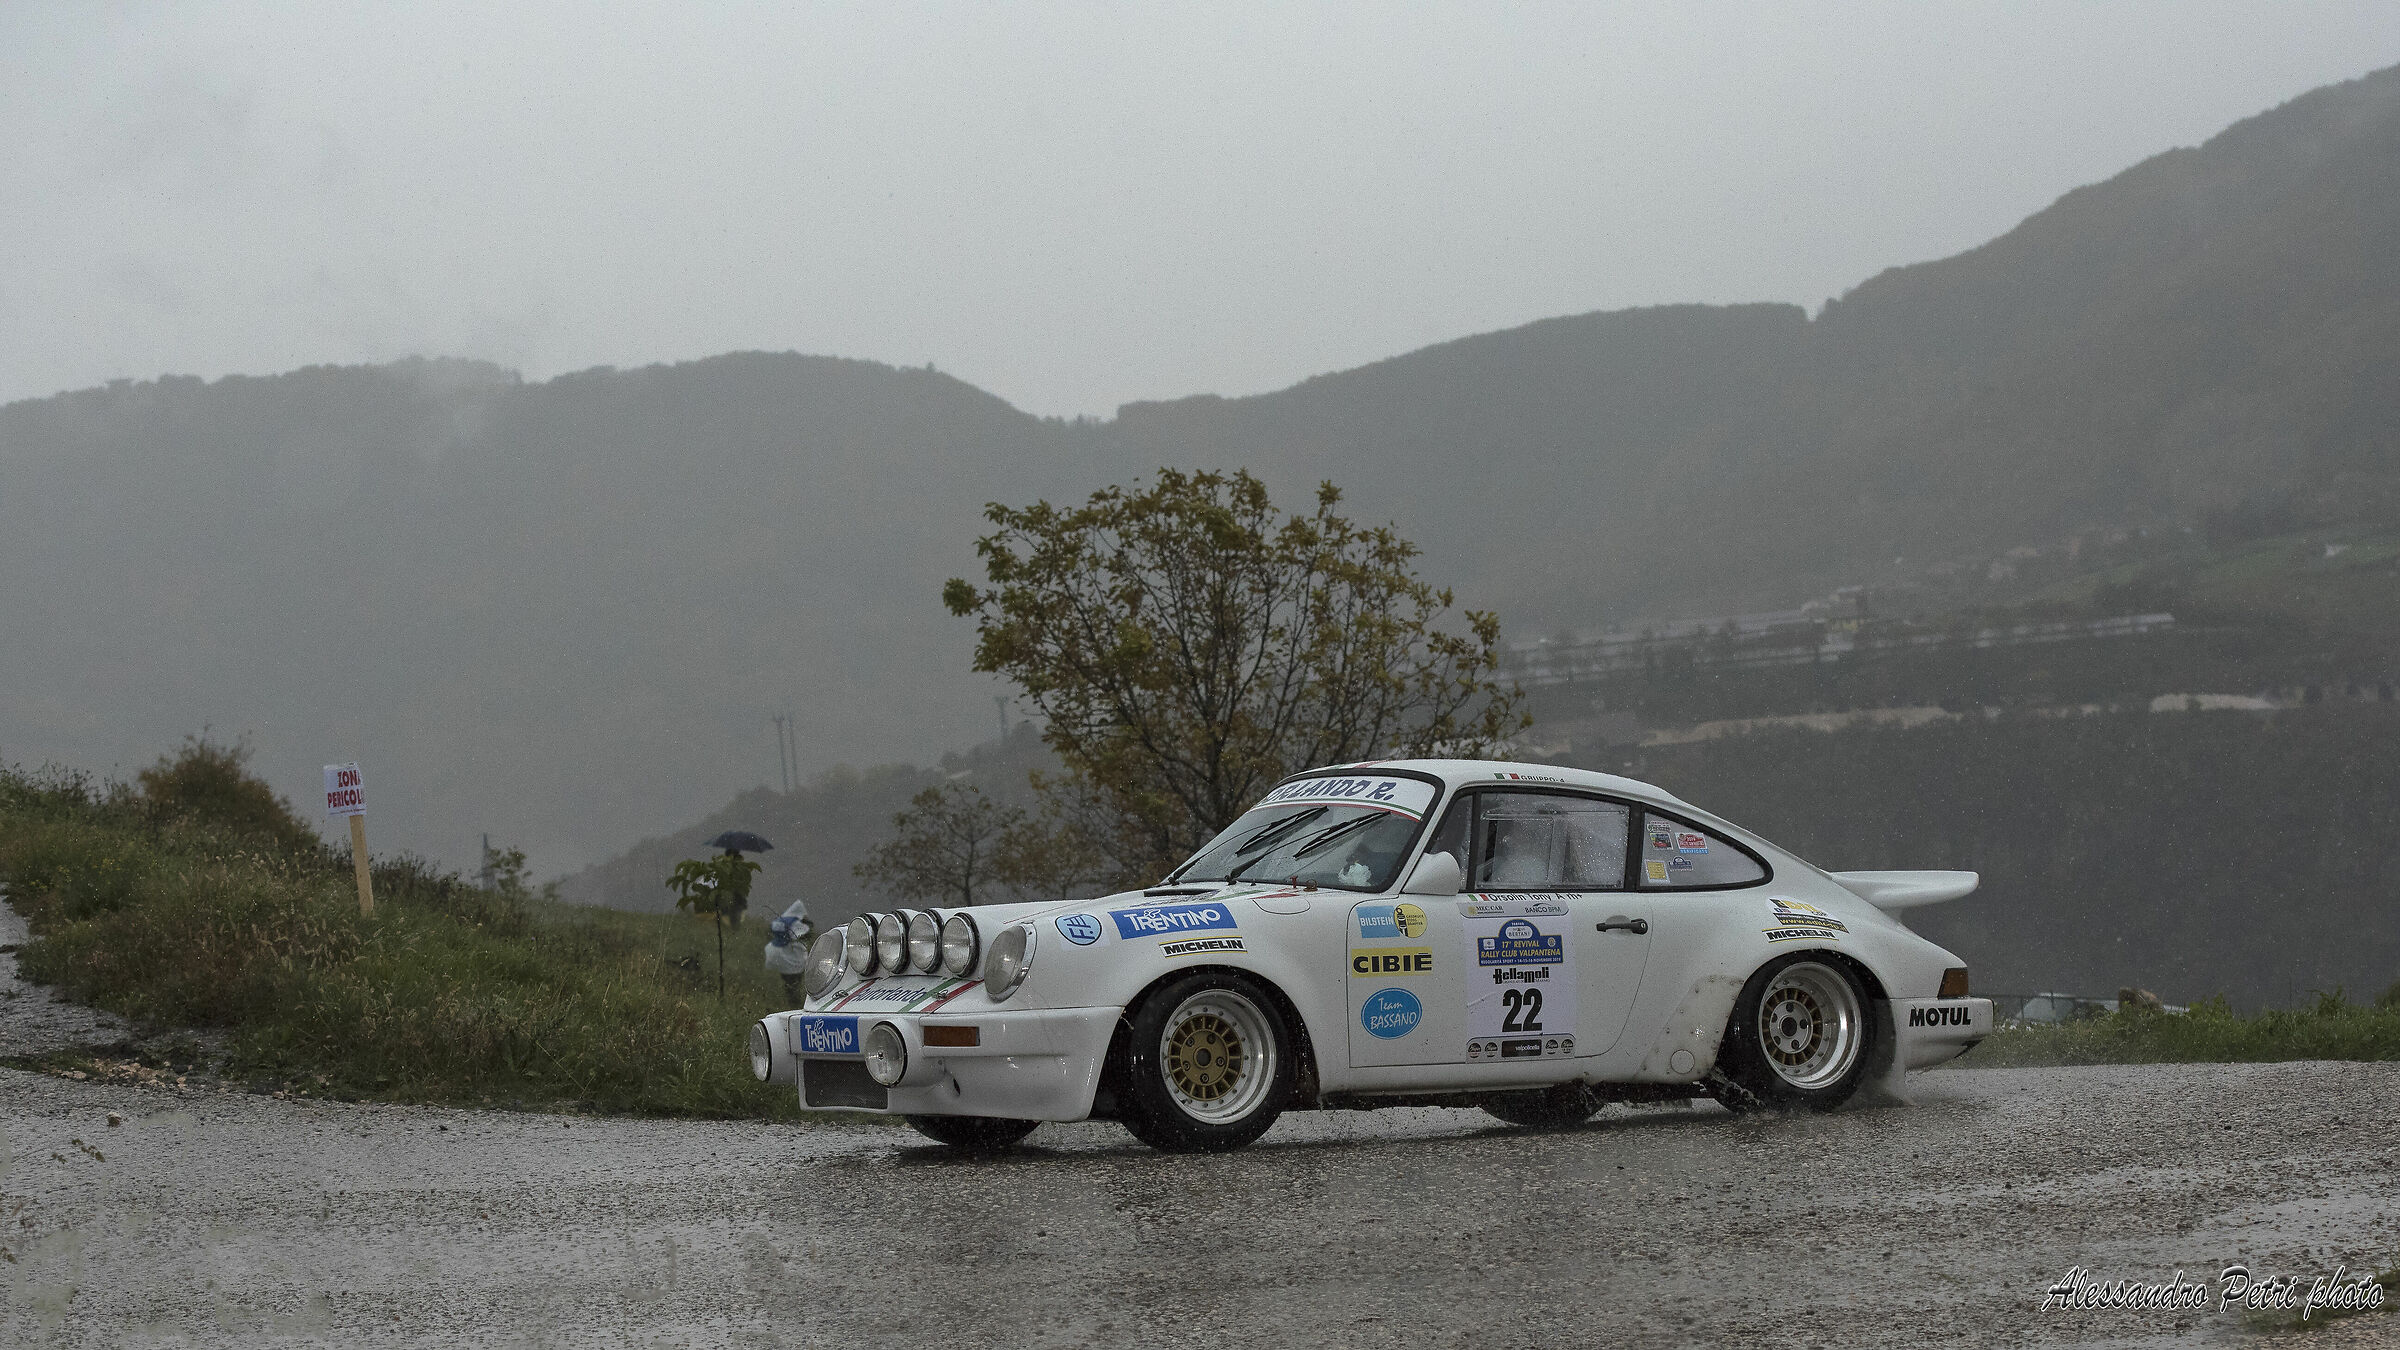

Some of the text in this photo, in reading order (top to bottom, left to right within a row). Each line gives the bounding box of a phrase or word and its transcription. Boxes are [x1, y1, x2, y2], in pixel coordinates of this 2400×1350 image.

[327, 788, 364, 809] PERICOL
[1266, 779, 1397, 802] ORLANDO R.
[1488, 893, 1526, 902] Orsolin
[1525, 906, 1548, 914] BANCO
[1124, 908, 1221, 931] TRENTINO
[1360, 916, 1394, 927] BILSTEIN
[1766, 929, 1836, 940] MICHELIN
[1164, 939, 1243, 955] MICHELIN
[1513, 940, 1540, 948] REVIVAL
[1481, 948, 1561, 958] RALLY CLUB VALPANTENA
[1492, 966, 1549, 985] Bellamoli
[1378, 997, 1403, 1011] Team
[1501, 988, 1543, 1033] 22
[1370, 1011, 1417, 1030] BASSANO
[1908, 1005, 1971, 1027] MOTUL
[805, 1024, 853, 1053] TRENTINO
